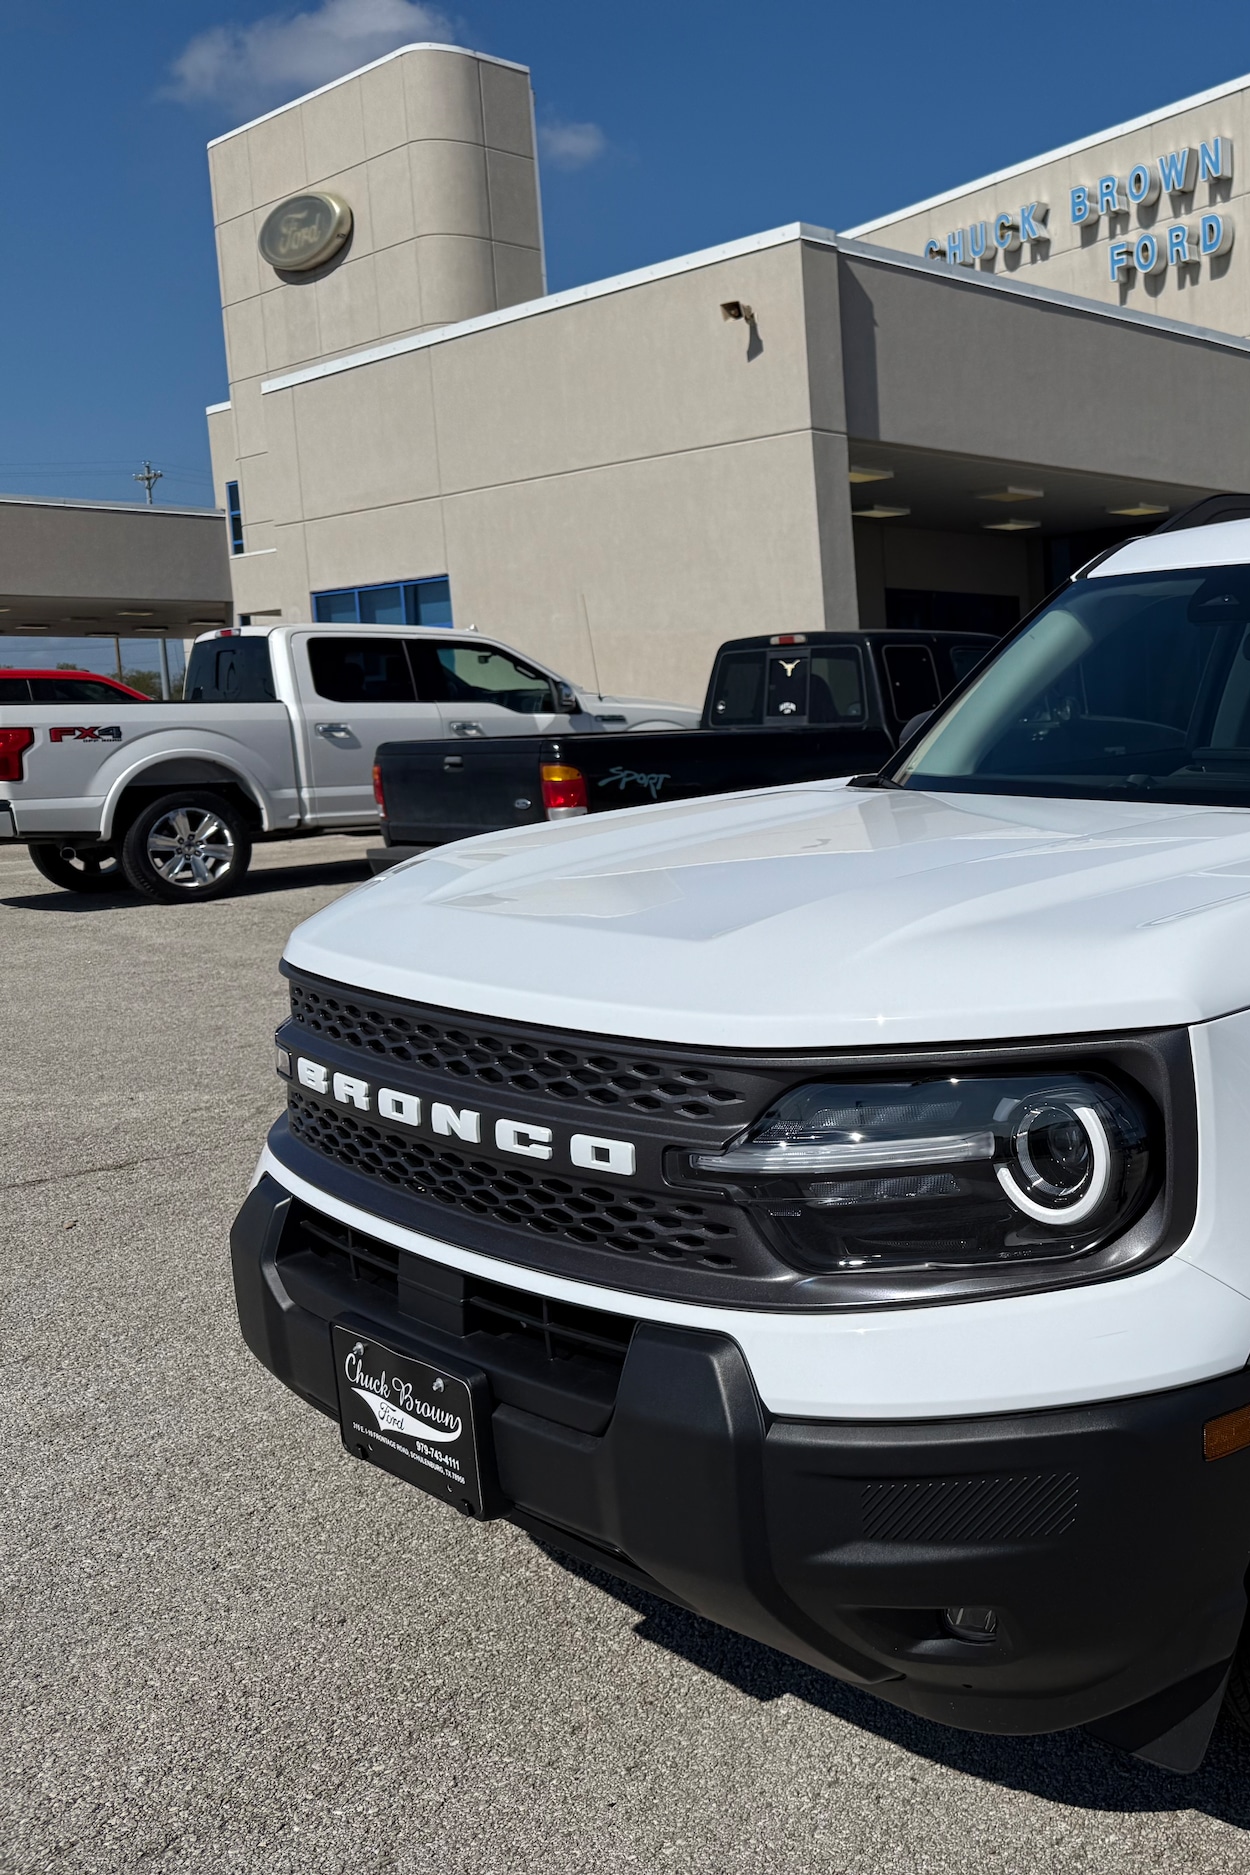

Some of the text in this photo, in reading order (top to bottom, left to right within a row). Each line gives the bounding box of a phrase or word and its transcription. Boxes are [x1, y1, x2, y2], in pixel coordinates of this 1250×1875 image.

[924, 136, 1232, 266] CHUCK BROWN
[279, 208, 322, 255] Ford
[1109, 213, 1230, 283] FORD
[49, 725, 123, 743] FX4
[598, 766, 672, 799] SPORT
[297, 1056, 636, 1176] BRONCO
[345, 1352, 462, 1430] Chuck Brown
[377, 1401, 405, 1431] Ford
[415, 1440, 460, 1471] 979-743-4111
